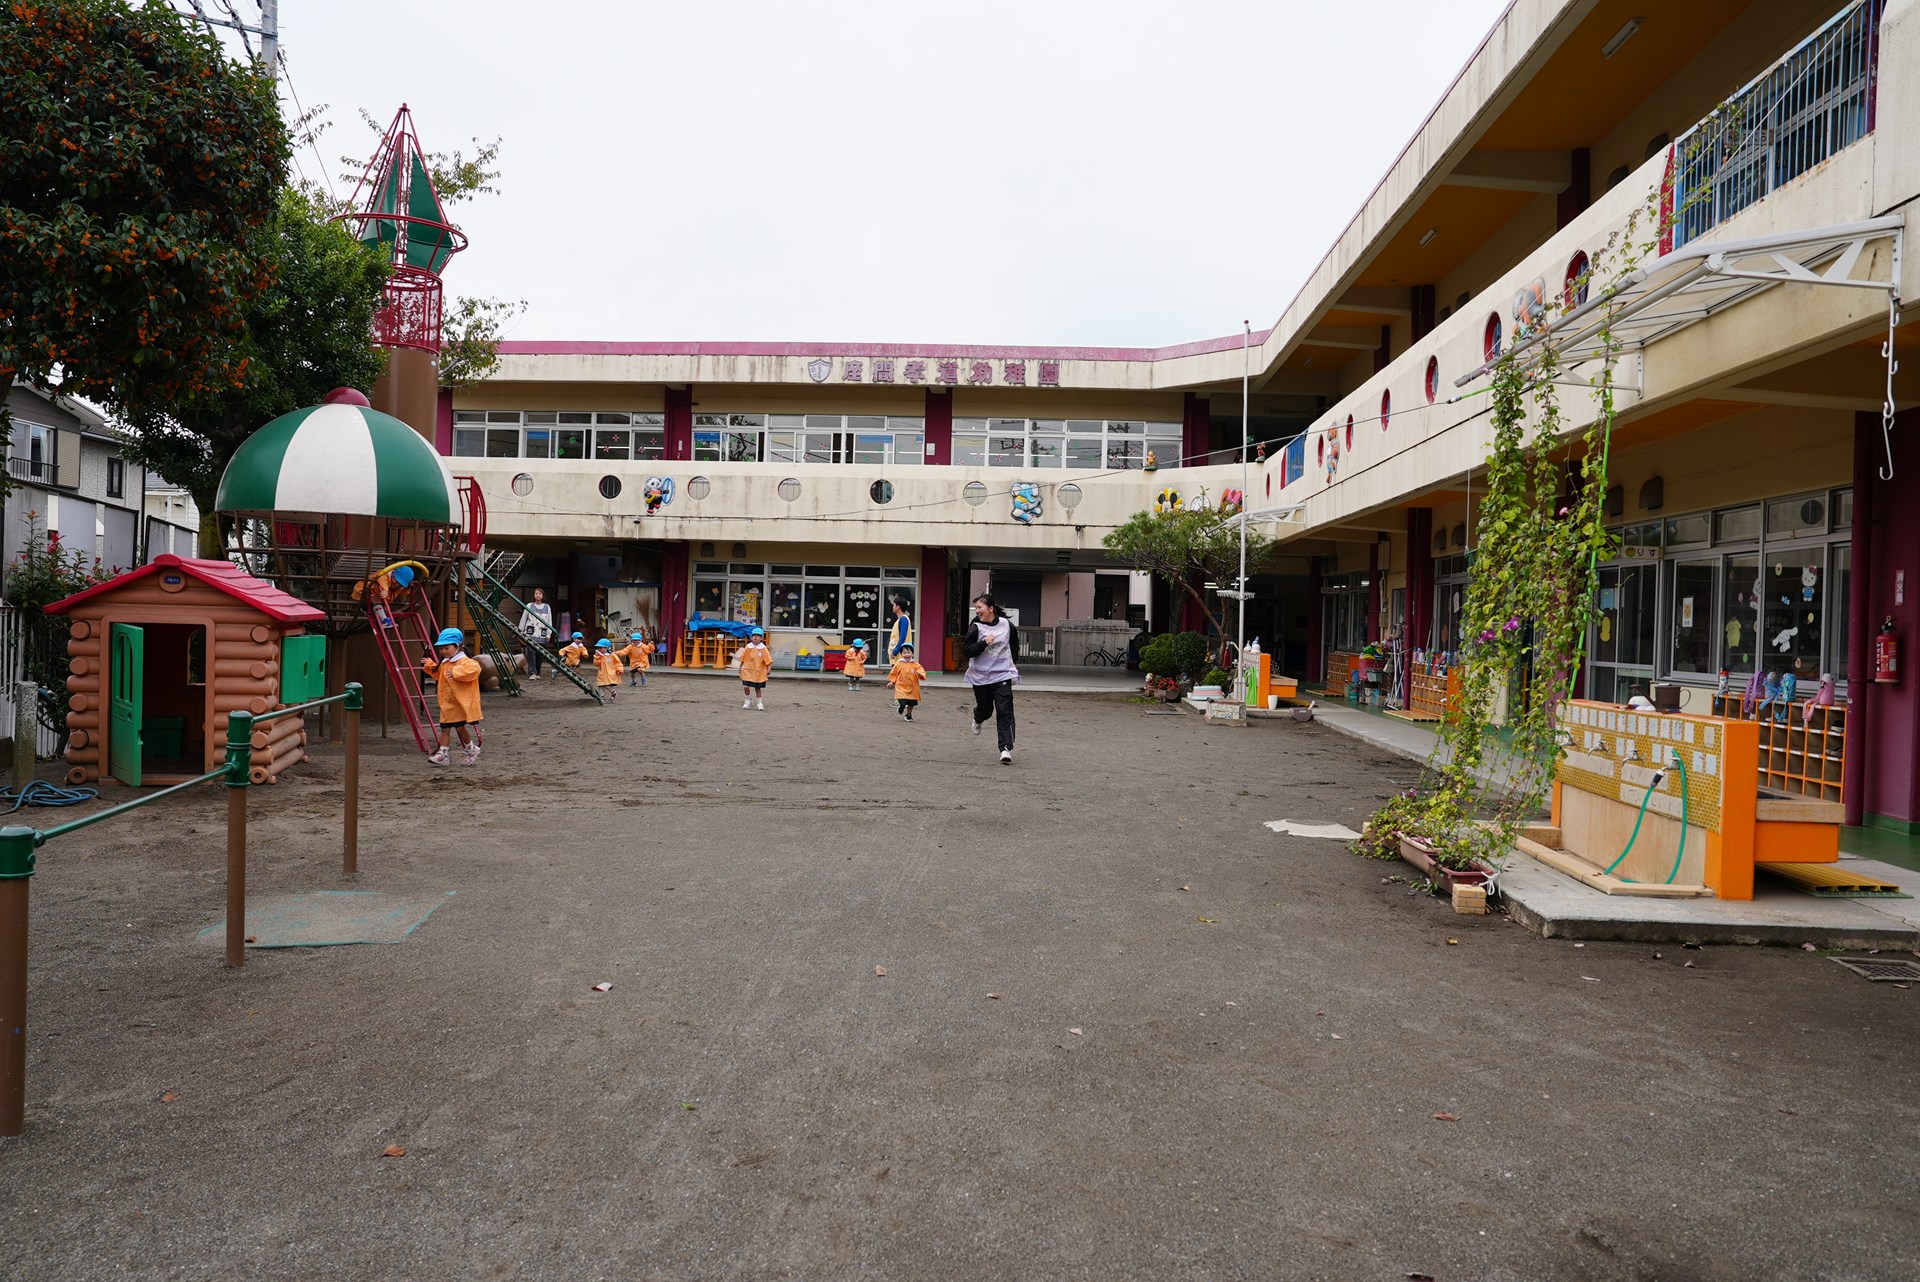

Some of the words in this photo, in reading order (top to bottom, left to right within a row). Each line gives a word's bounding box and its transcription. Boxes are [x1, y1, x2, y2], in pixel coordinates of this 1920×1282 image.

[842, 360, 1060, 385] 座間孝道幼稚園
[1637, 548, 1657, 558] りす
